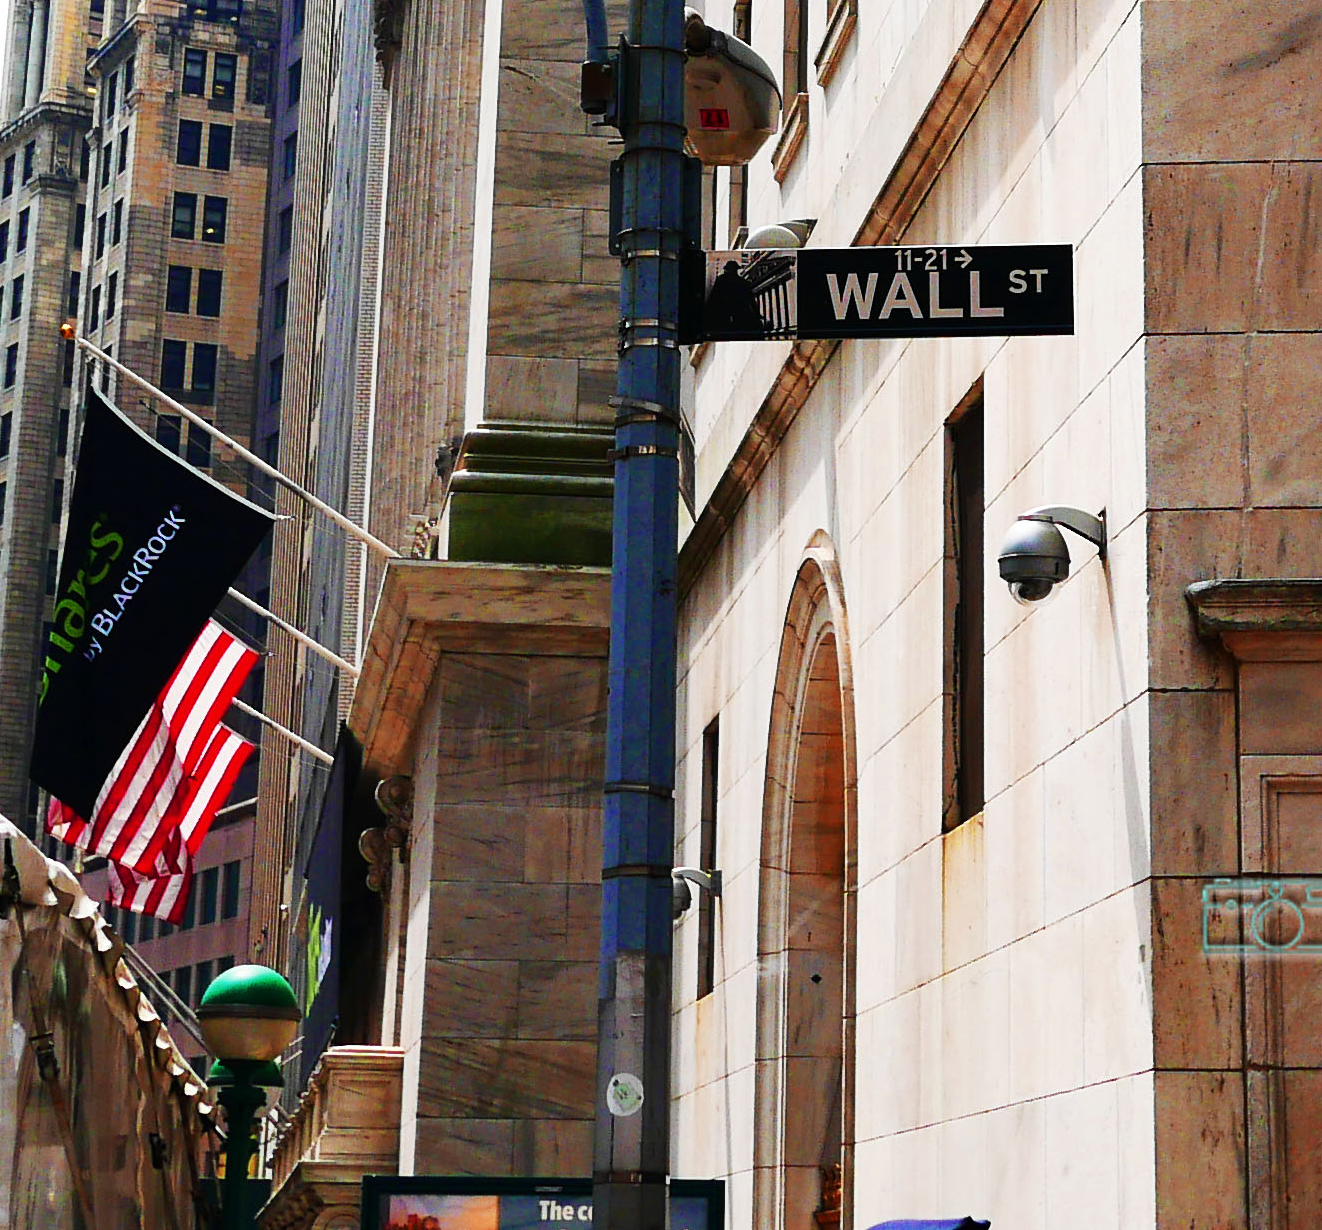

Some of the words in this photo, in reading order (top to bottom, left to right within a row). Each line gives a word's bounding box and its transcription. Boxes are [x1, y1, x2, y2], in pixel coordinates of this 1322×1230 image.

[894, 248, 948, 271] 11-21
[825, 270, 1005, 320] WALL
[1008, 268, 1049, 294] ST
[82, 636, 103, 663] by
[539, 1199, 575, 1222] The
